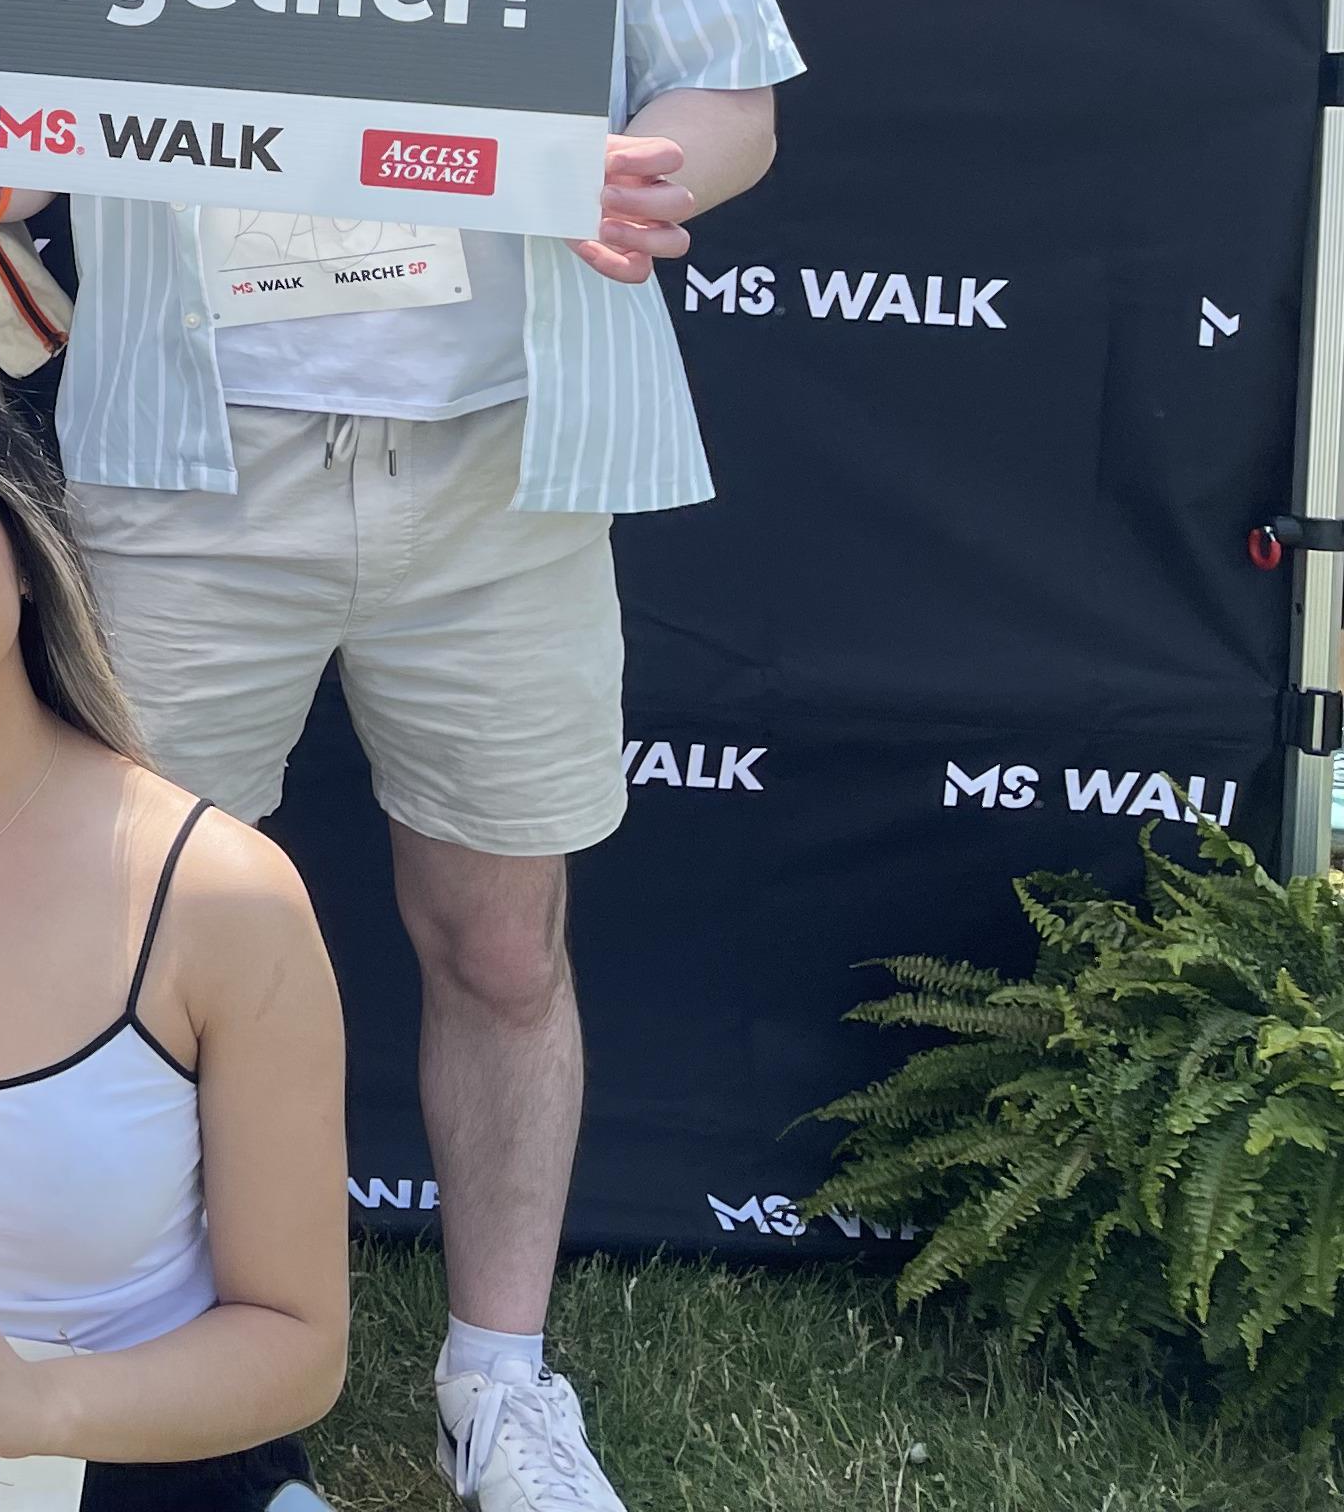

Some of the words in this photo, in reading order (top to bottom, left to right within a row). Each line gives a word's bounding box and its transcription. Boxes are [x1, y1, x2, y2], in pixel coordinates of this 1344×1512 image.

[99, 112, 283, 172] WALK
[379, 138, 480, 170] ACCESS
[377, 158, 478, 184] STORAGE
[258, 276, 304, 294] WALK
[334, 264, 405, 285] MARCHE
[408, 261, 428, 276] SP
[685, 264, 776, 317] MS
[800, 268, 1010, 329] WALK
[620, 740, 768, 791] ALK
[942, 760, 1040, 810] MS
